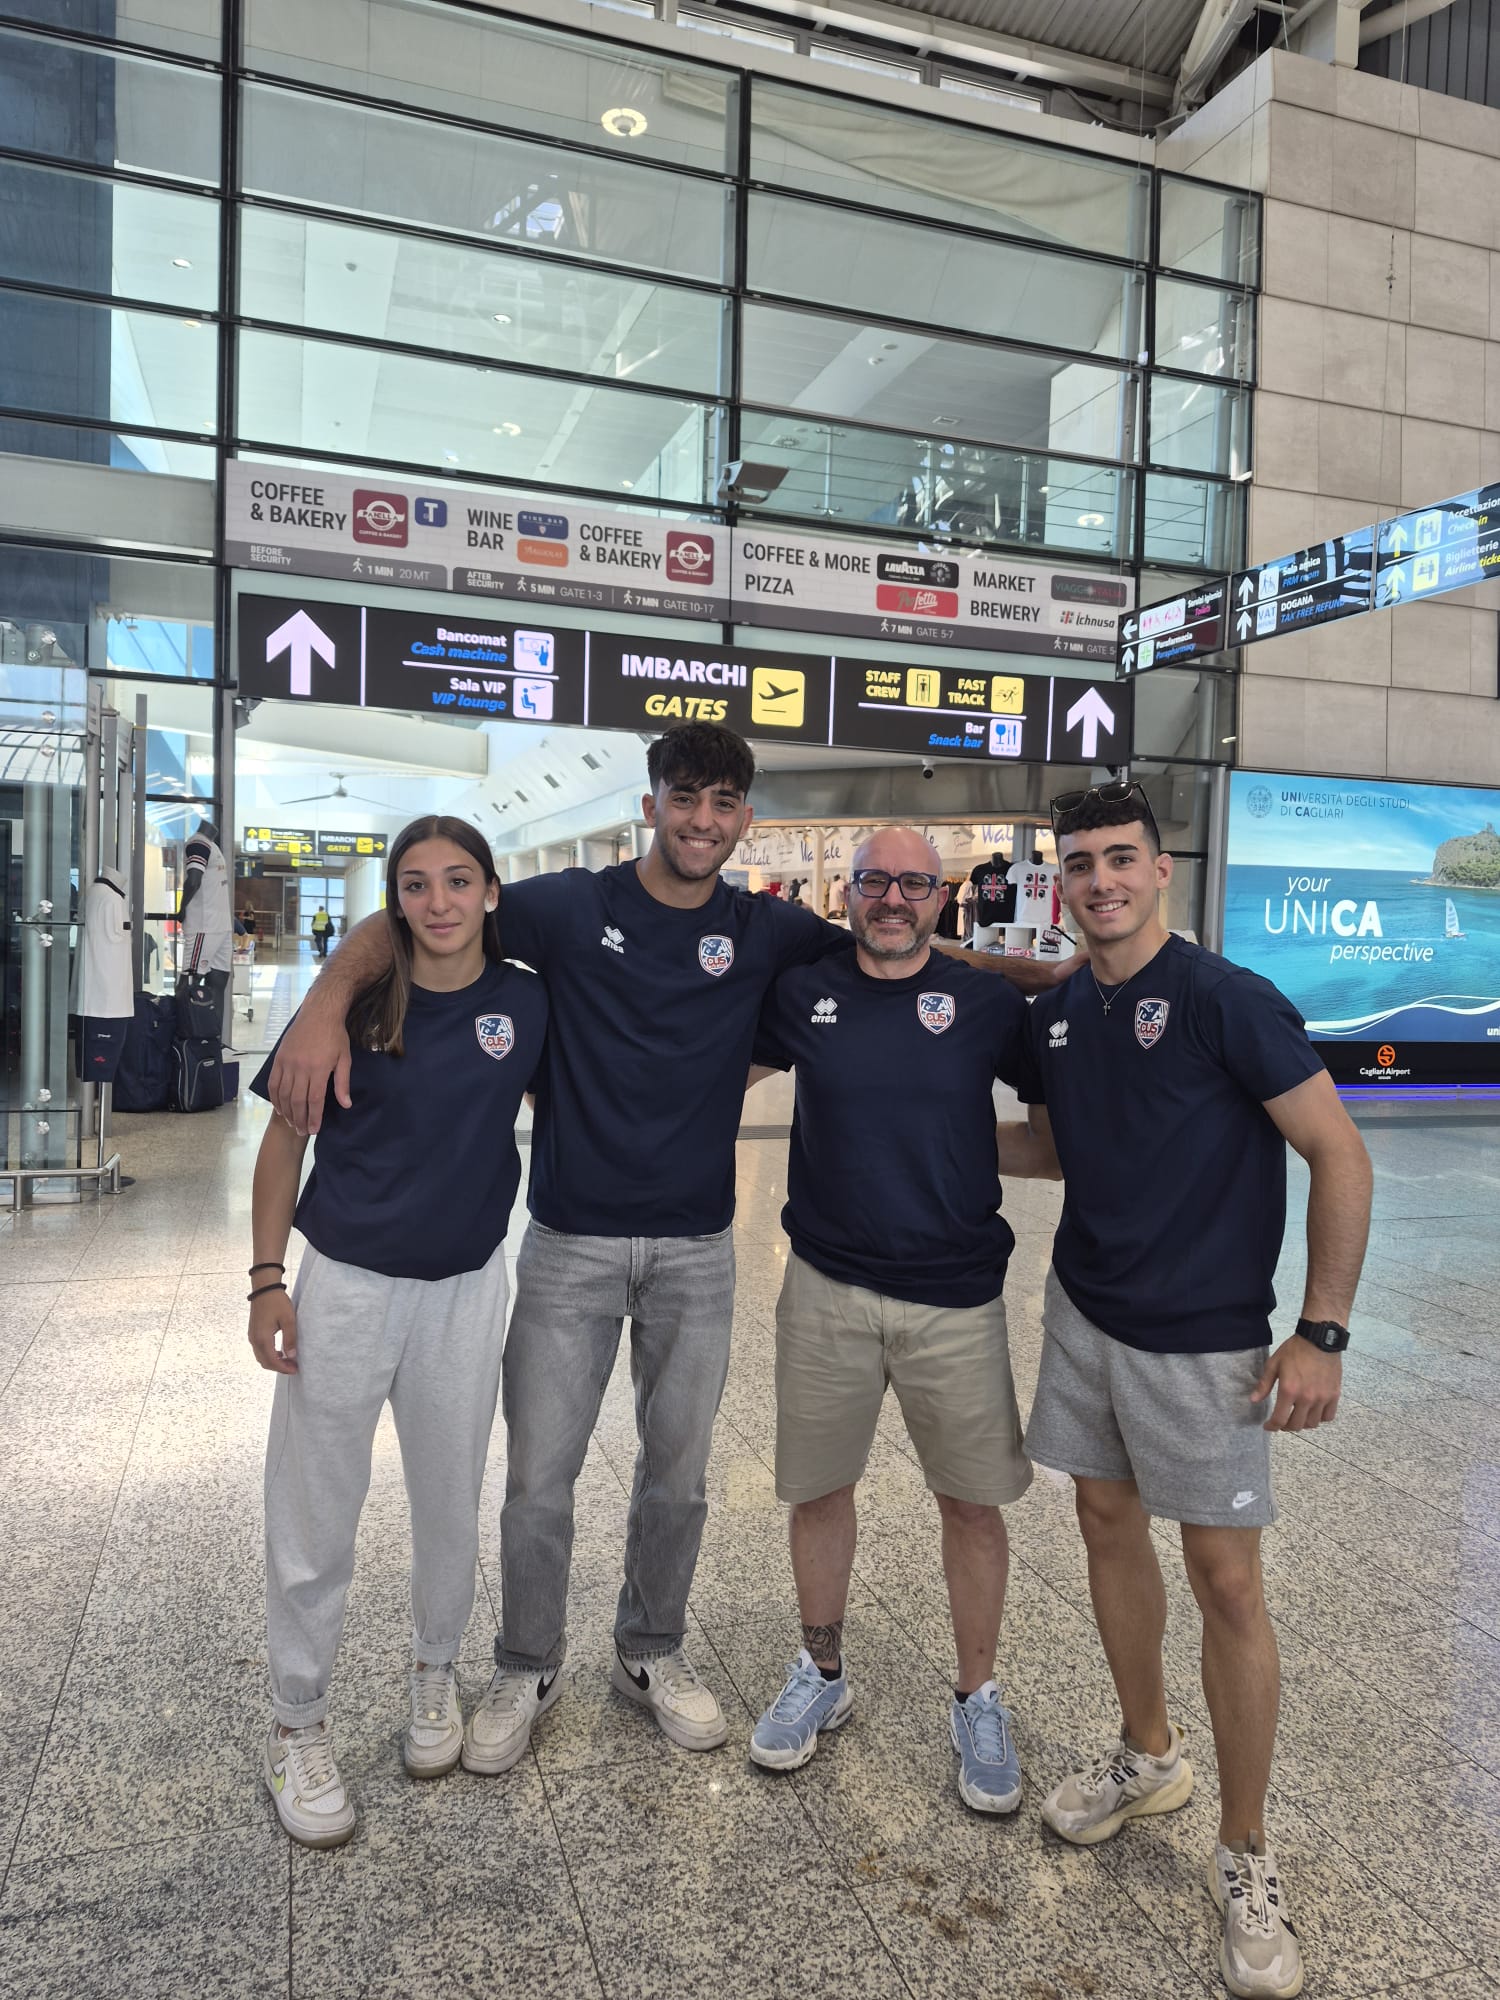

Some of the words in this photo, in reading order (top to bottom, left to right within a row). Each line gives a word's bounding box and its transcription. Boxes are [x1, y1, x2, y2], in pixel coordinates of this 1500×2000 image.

[251, 480, 324, 506] COFFEE
[250, 503, 264, 521] &
[270, 505, 347, 531] BAKERY
[423, 502, 438, 523] T
[467, 508, 513, 531] WINE
[467, 530, 504, 551] BAR
[580, 523, 643, 547] COFFEE
[250, 553, 292, 566] SECURITY
[251, 545, 283, 557] BEFORE
[579, 546, 591, 562] &
[596, 546, 662, 570] BAKERY
[743, 542, 805, 566] COFFEE
[809, 551, 820, 568] &
[825, 553, 871, 574] MORE
[1446, 540, 1499, 563] Biglietterie
[367, 565, 373, 576] 1
[374, 566, 394, 577] MIN
[467, 570, 492, 582] AFTER
[885, 561, 925, 576] LAVAZZA
[1444, 561, 1477, 577] Airline
[467, 578, 504, 590] SECURITY
[745, 573, 794, 595] PIZZA
[974, 571, 1036, 593] MARKET
[530, 583, 537, 593] 5
[537, 584, 556, 596] MIN
[560, 586, 585, 599] GATE
[587, 588, 603, 601] 1-3
[635, 595, 642, 605] 7
[642, 596, 660, 608] MIN
[663, 599, 689, 611] GATE
[690, 601, 714, 614] 10-17
[970, 600, 1040, 622] BREWERY
[1281, 594, 1314, 612] DOGANA
[1281, 611, 1295, 623] TAX
[1296, 607, 1315, 618] FREE
[1315, 598, 1345, 613] REFUND
[1076, 612, 1115, 628] ichnusa
[436, 628, 507, 647] Bancomat
[891, 624, 896, 633] 7
[897, 625, 913, 635] MIN
[916, 627, 938, 637] GATE
[941, 629, 954, 639] 5-7
[411, 641, 446, 656] Cash
[448, 645, 508, 663] machine
[1063, 642, 1068, 651] 7
[1069, 643, 1084, 652] MIN
[1086, 644, 1107, 655] GATE
[621, 653, 747, 687] IMBARCHI
[866, 670, 901, 684] STAFF
[450, 678, 480, 692] Sala
[482, 680, 506, 693] VIP
[866, 685, 901, 699] CREW
[958, 678, 986, 692] FAST
[432, 692, 456, 705] VIP
[458, 693, 508, 711] lounge
[645, 694, 728, 721] GATES
[948, 691, 985, 706] TRACK
[965, 722, 985, 735] Bar
[928, 733, 961, 747] Snack
[963, 736, 984, 748] bar
[1346, 795, 1376, 807] DEGLI
[1379, 797, 1410, 809] STUDI
[1280, 806, 1291, 816] DI
[1295, 807, 1344, 819] CAGLIARI
[1285, 876, 1331, 896] your
[1265, 898, 1383, 938] UNICA
[1330, 942, 1433, 965] perspective
[1360, 1067, 1385, 1077] Cagliari
[1386, 1067, 1410, 1077] Airport
